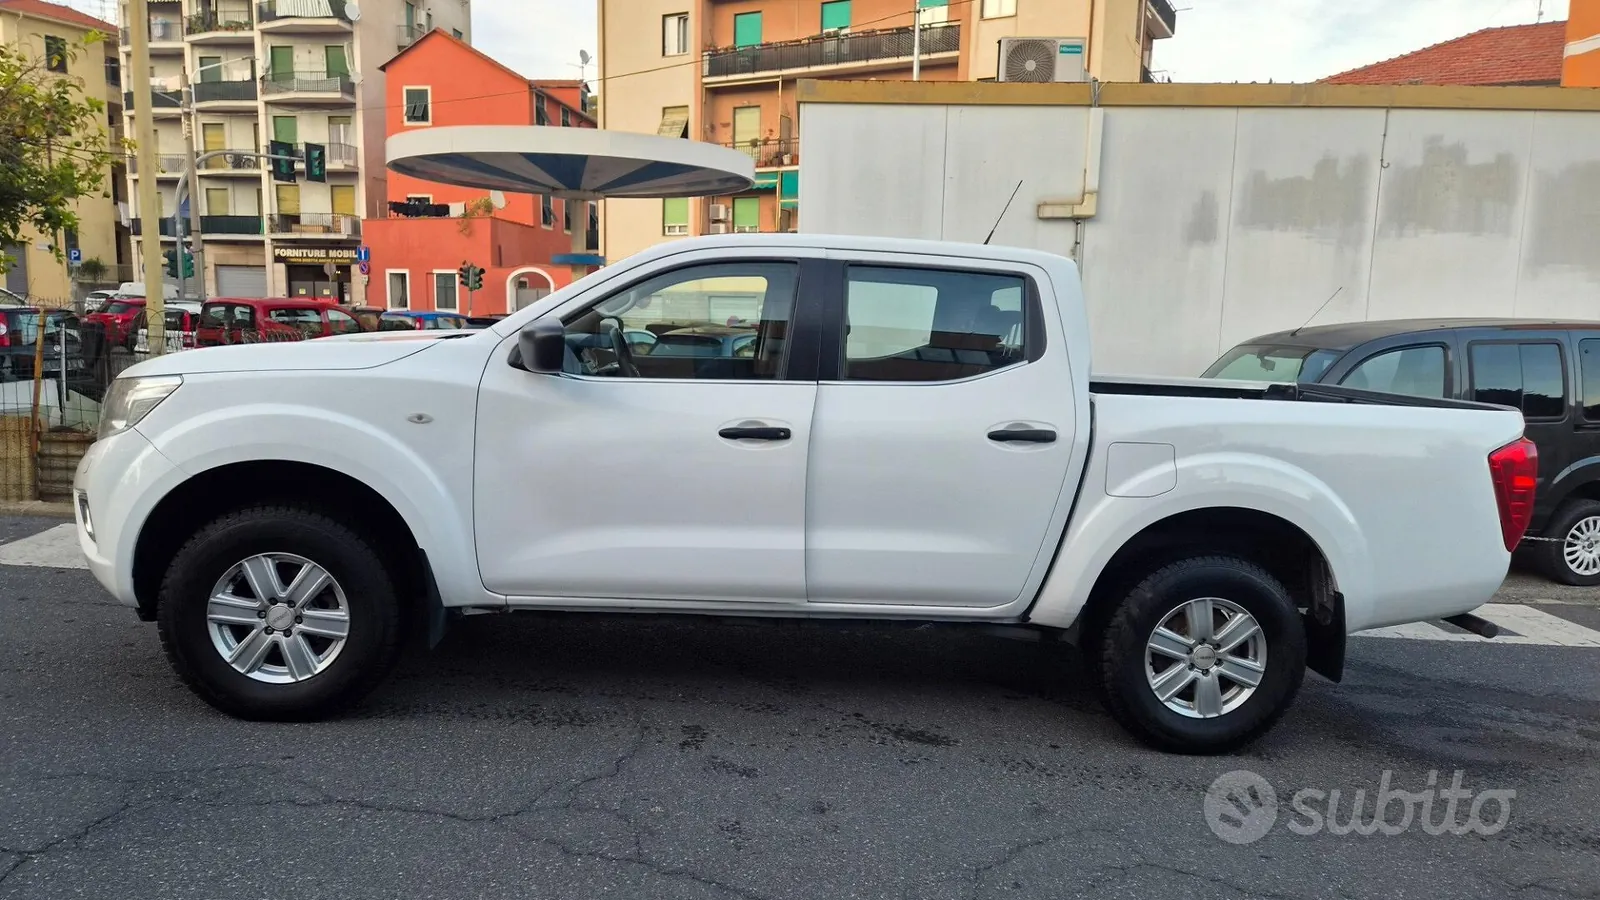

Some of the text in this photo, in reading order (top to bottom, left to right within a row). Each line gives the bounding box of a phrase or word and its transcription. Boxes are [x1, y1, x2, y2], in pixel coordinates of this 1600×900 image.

[71, 250, 79, 260] P
[274, 248, 358, 258] FORNITURE MOBIL
